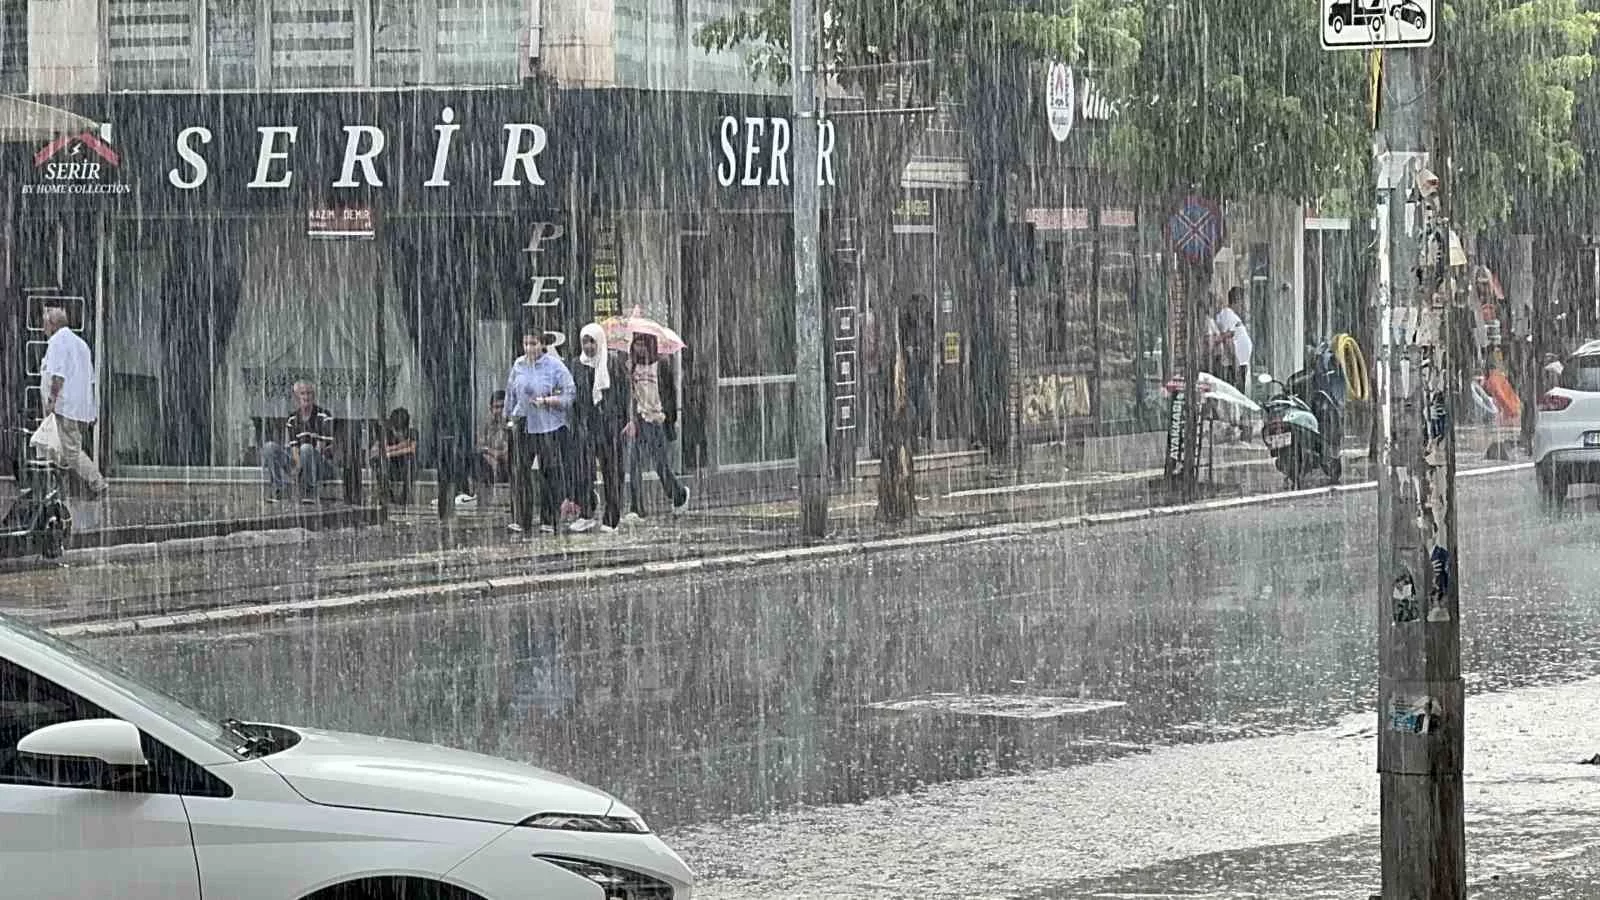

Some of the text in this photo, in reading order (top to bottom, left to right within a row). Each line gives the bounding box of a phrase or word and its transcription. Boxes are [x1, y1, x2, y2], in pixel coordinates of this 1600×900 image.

[45, 159, 101, 180] SERİR
[168, 106, 547, 189] SERİR
[718, 115, 836, 187] SERR
[22, 184, 130, 194] BY HOME COLLECTION
